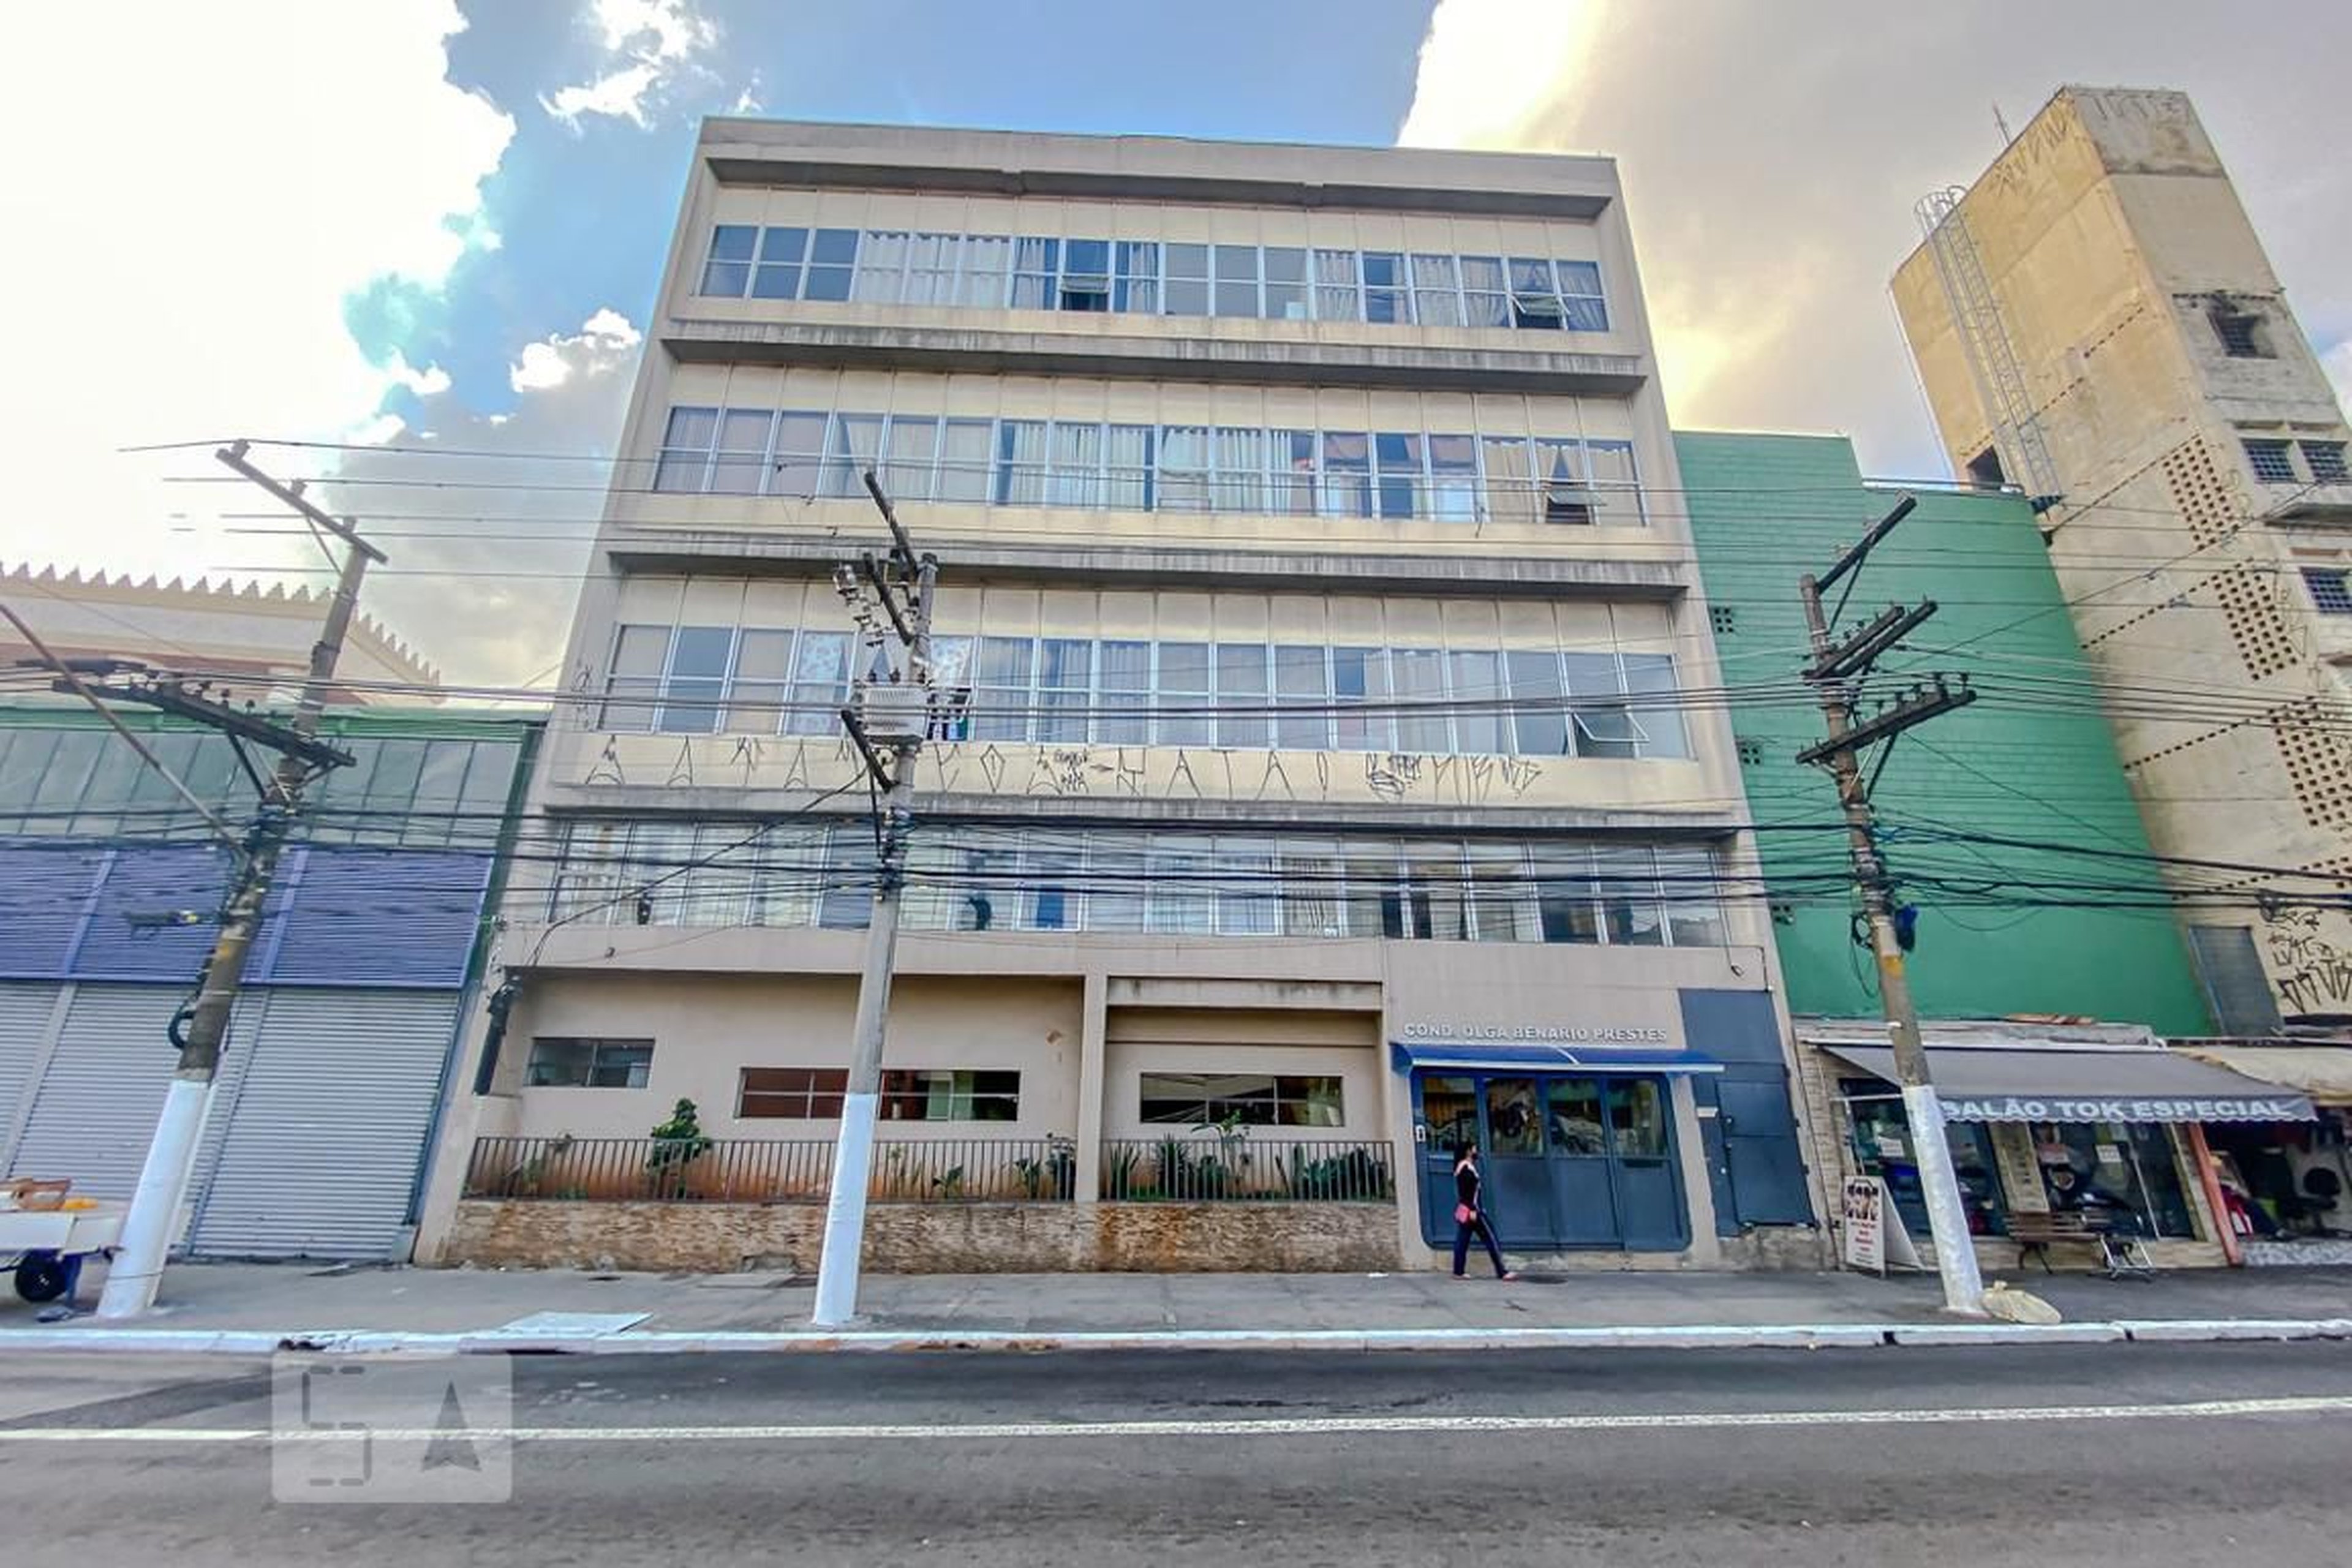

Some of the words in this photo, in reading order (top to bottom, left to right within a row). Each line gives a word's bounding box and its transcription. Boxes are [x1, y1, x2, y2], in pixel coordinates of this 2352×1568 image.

[1514, 1027, 1588, 1041] BENARIO
[1594, 1028, 1667, 1041] PRESTES
[1942, 1099, 2047, 1117] SALÃO
[2054, 1102, 2124, 1118] TOK
[2132, 1102, 2291, 1117] ESPECIAL
